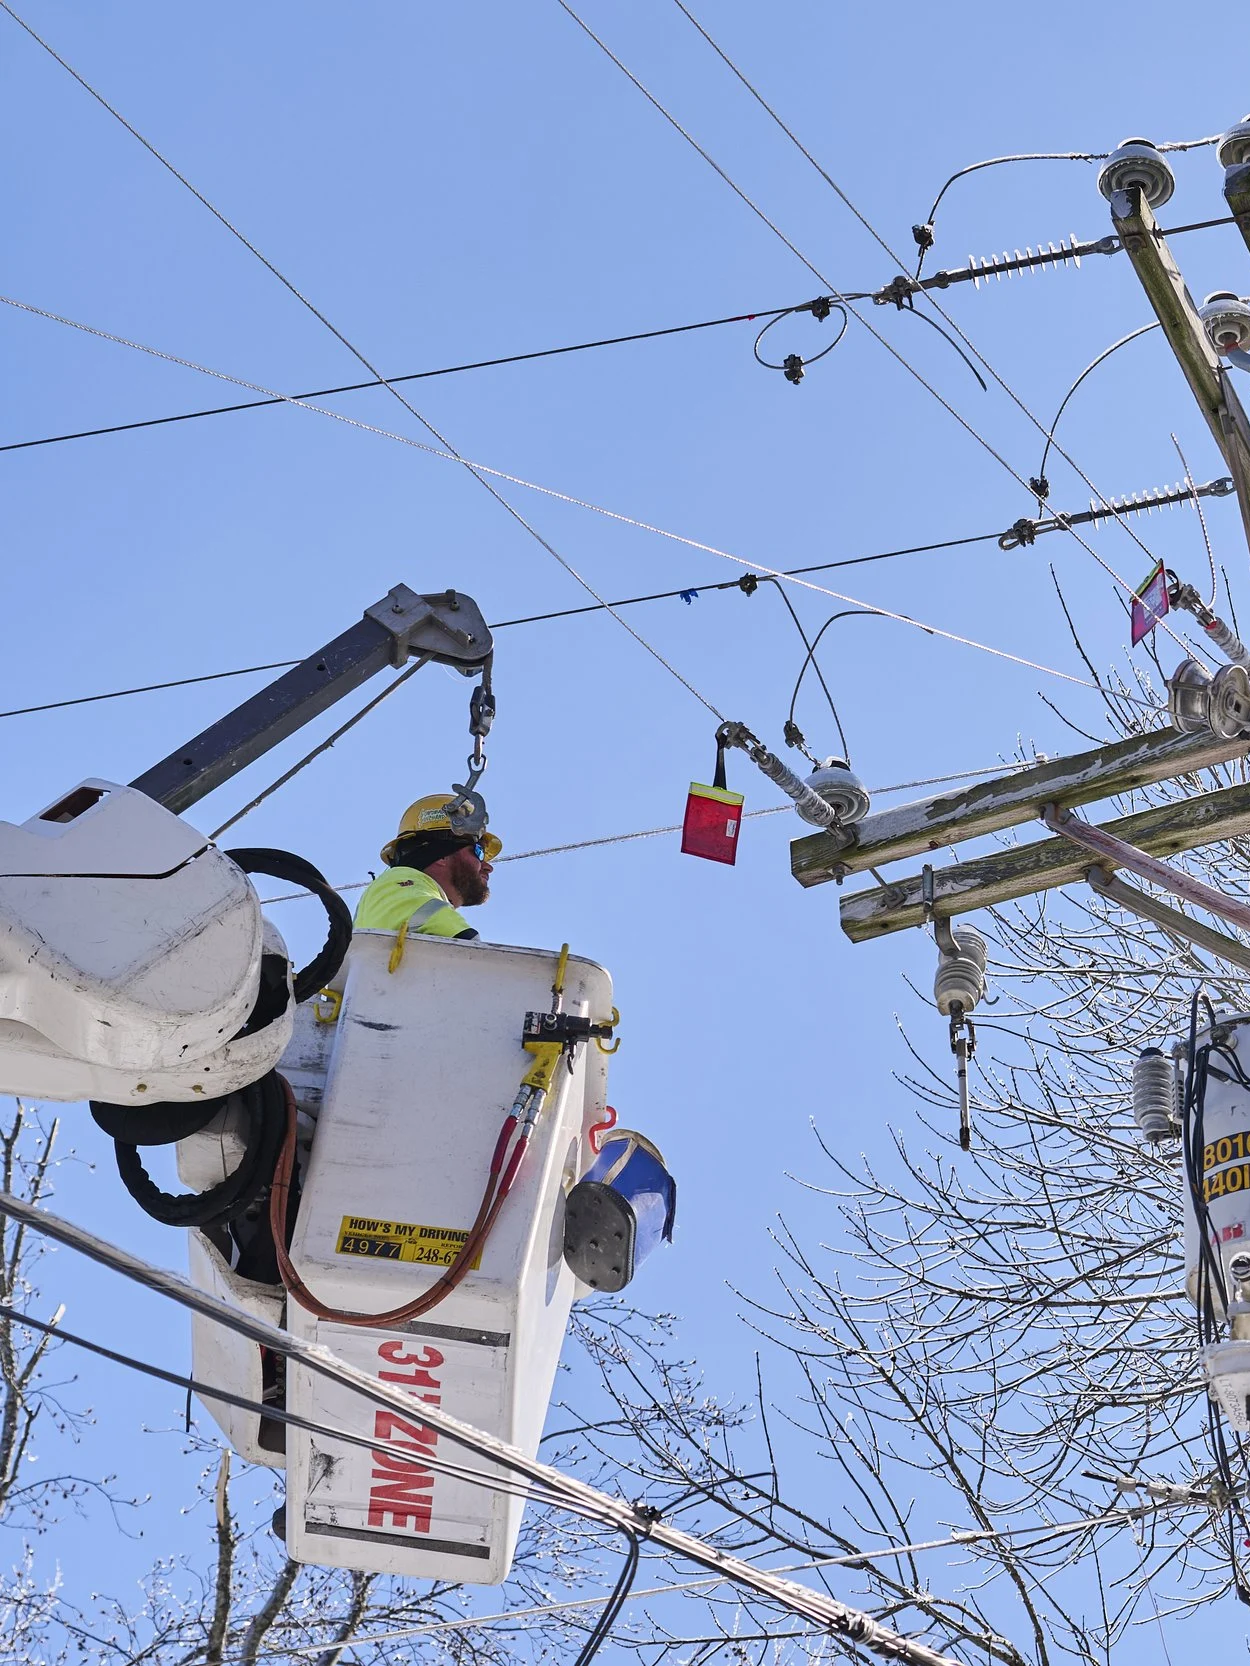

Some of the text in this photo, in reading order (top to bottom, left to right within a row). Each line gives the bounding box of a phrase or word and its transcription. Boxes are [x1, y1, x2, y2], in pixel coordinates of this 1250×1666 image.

[349, 1218, 391, 1233] HOW'S
[395, 1225, 416, 1237] MY
[344, 1238, 400, 1257] 4977
[368, 1410, 438, 1533] ZONE
